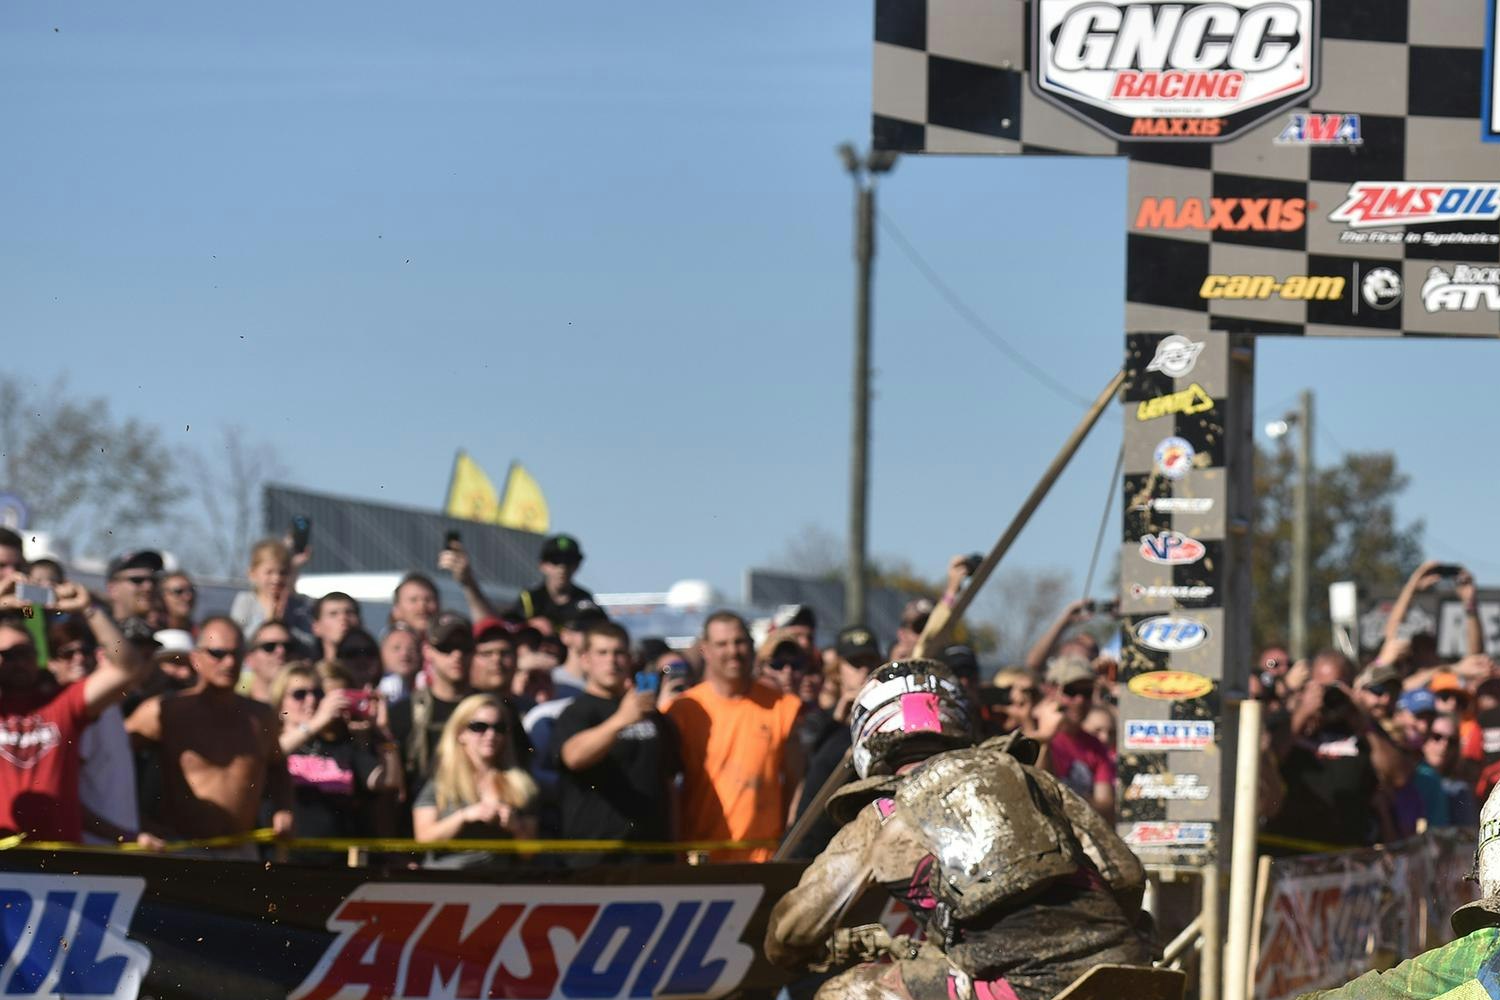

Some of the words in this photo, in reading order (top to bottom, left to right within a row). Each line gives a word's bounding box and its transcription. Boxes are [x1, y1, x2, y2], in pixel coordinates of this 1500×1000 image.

[1053, 3, 1300, 72] GNCC
[1111, 70, 1244, 100] RACING
[1130, 117, 1222, 137] MAXXIS
[1276, 113, 1362, 144] AMA
[1135, 196, 1306, 232] MAXXIS
[1199, 274, 1346, 300] can-am
[1142, 622, 1202, 643] ITP
[1128, 722, 1211, 737] PARTS
